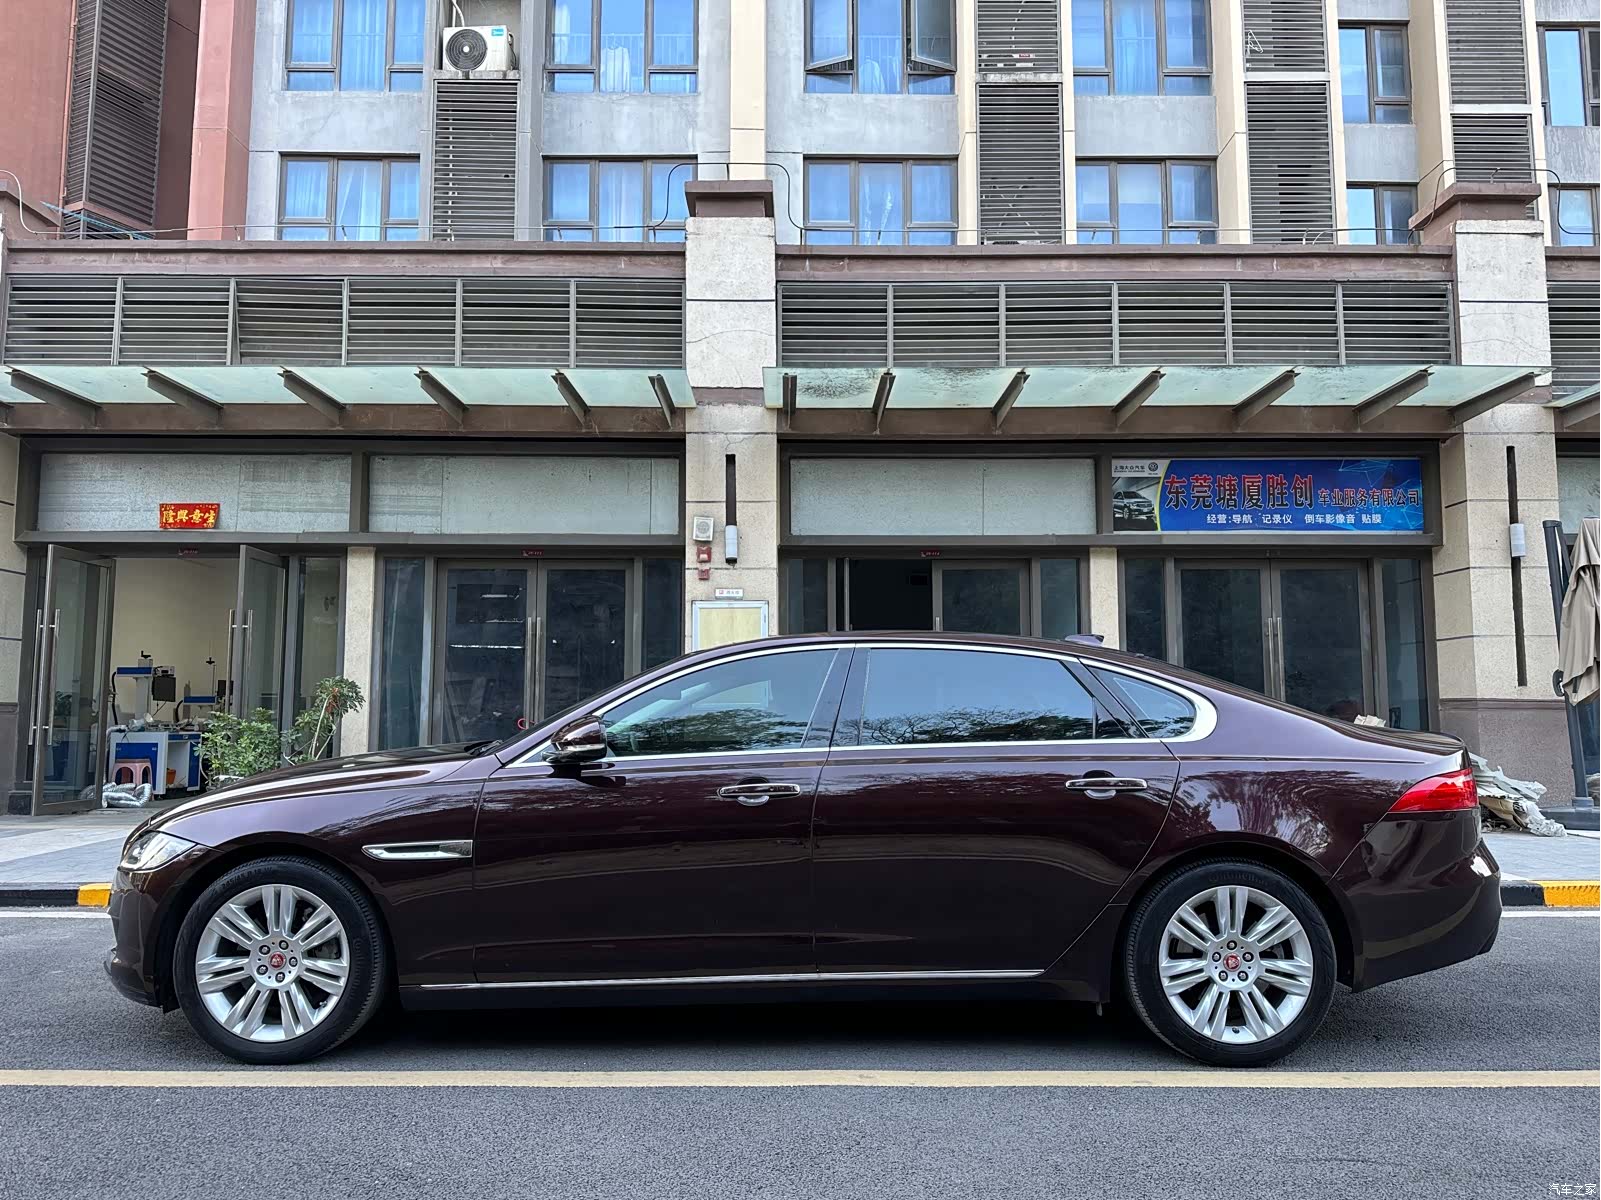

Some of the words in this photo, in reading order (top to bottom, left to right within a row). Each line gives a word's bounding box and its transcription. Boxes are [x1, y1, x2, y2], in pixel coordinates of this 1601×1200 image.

[1164, 474, 1315, 510] 东莞塘厦胜创
[1318, 488, 1421, 508] 车业服务有限公司
[1261, 513, 1293, 524] 记录仪
[1304, 513, 1356, 524] 倒车影像音
[1361, 513, 1383, 524] 贴膜
